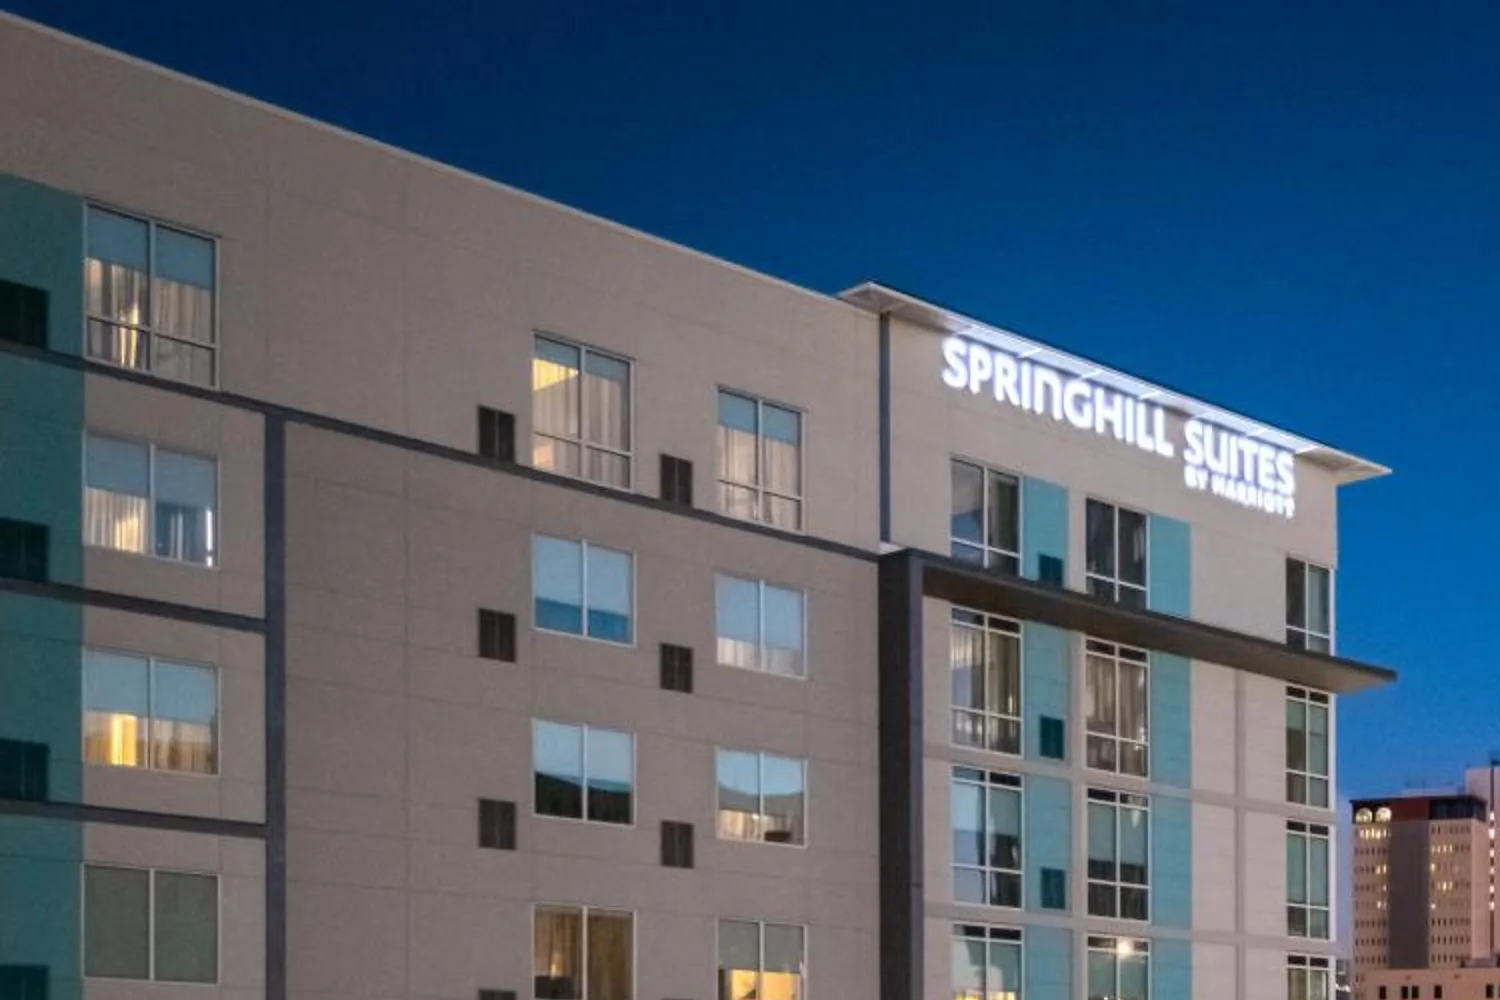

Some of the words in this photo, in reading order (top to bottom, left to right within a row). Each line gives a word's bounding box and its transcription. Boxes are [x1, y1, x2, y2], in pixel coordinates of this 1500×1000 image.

[940, 335, 1174, 458] SPRINGHILL
[1183, 417, 1296, 497] SUITES
[1183, 464, 1208, 491] BY
